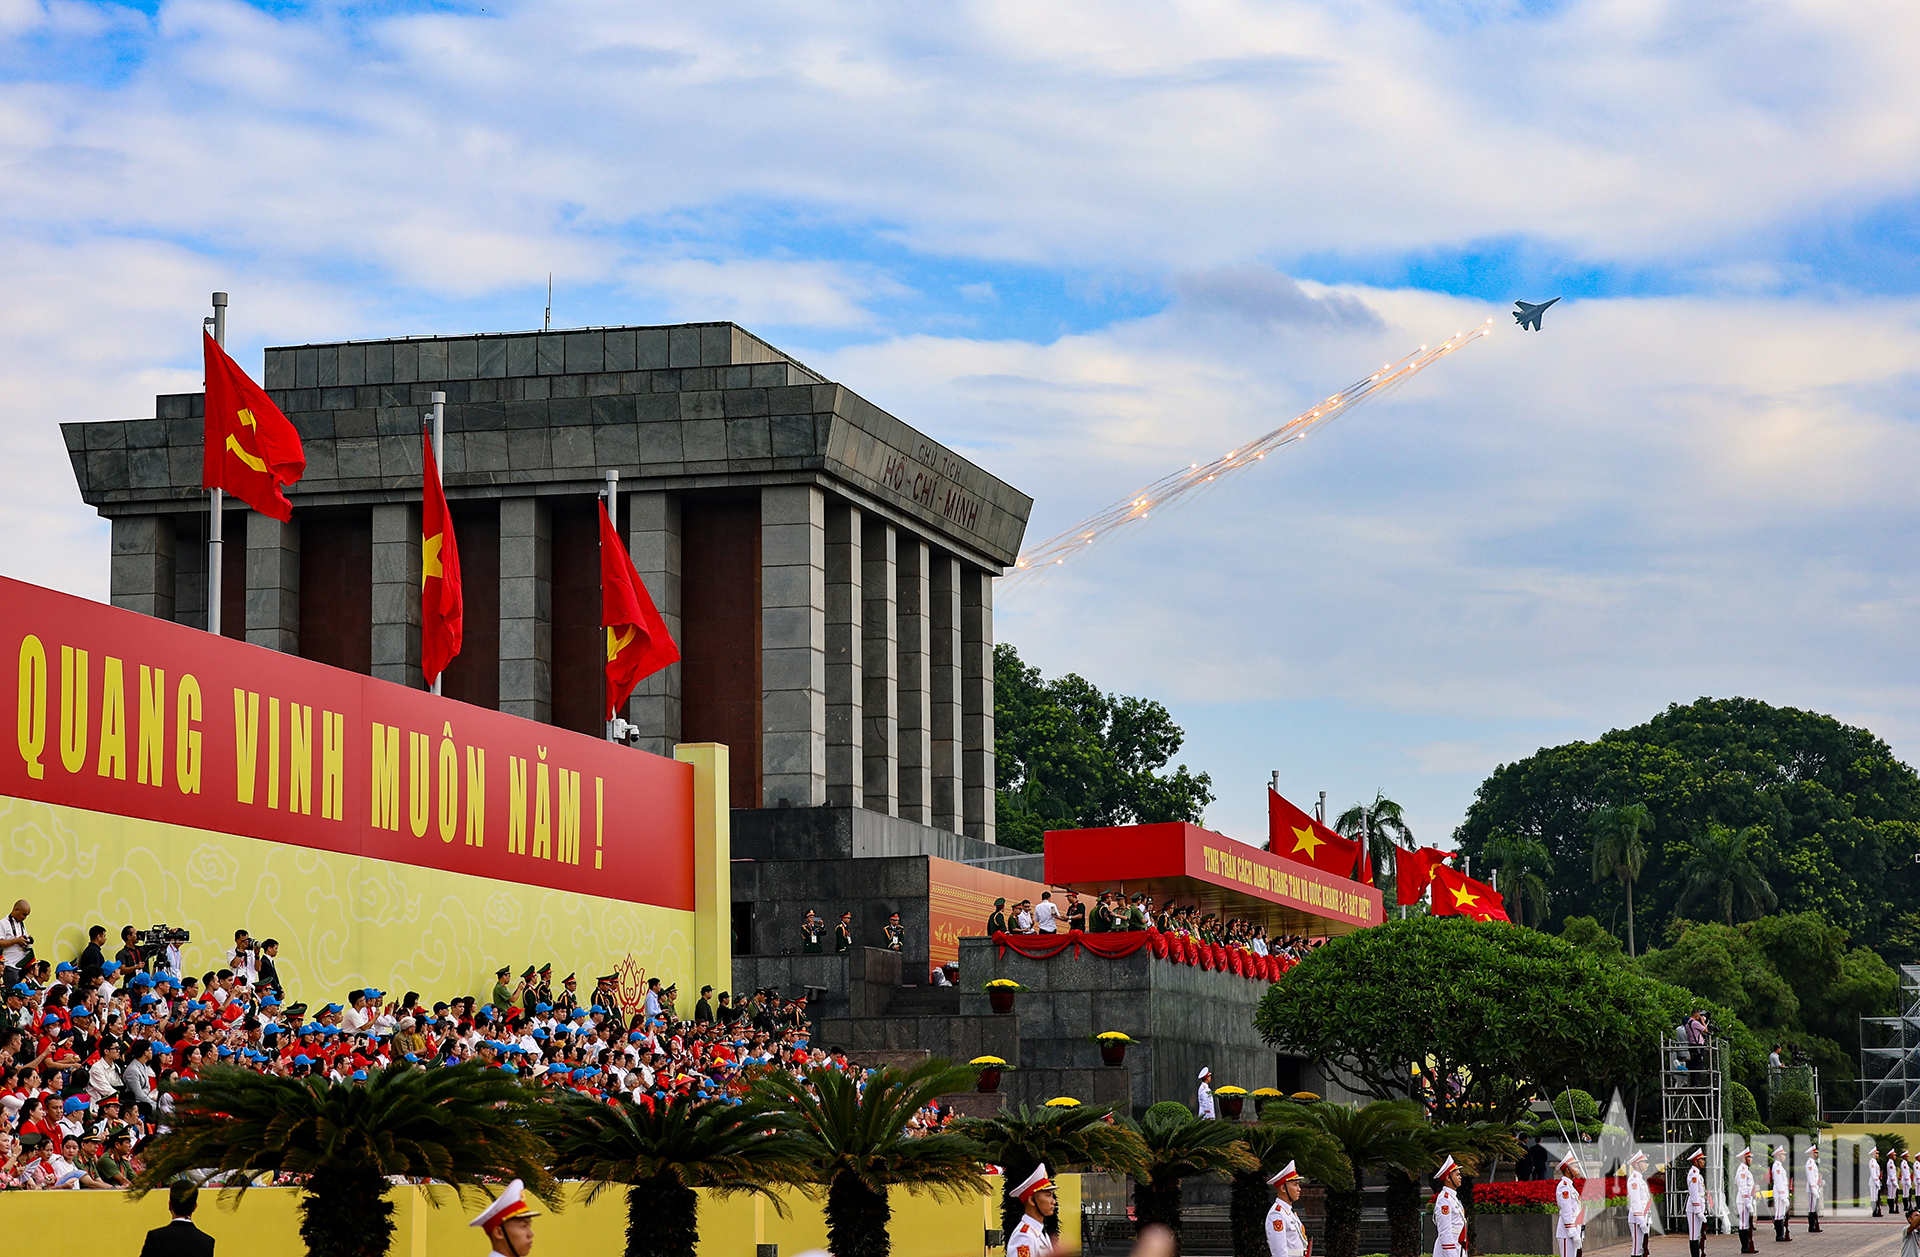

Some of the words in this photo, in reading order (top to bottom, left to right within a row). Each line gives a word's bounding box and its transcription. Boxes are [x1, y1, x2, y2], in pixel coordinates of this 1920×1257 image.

[17, 634, 203, 795] QUANG
[233, 687, 344, 822] VINH
[371, 720, 486, 848] MUÔN
[508, 744, 581, 866] NĂM
[1203, 845, 1220, 875] TINH
[1220, 846, 1237, 880] THẦN
[1237, 853, 1253, 886] CÁCH
[1253, 862, 1269, 893] MẠNG
[1270, 866, 1288, 897] THÁNG
[1288, 871, 1301, 900] TÁM
[1301, 875, 1309, 903] VÀ
[1309, 876, 1322, 907] QUỐC
[1322, 883, 1339, 912] KHÁNH
[1339, 890, 1349, 915] 2-9
